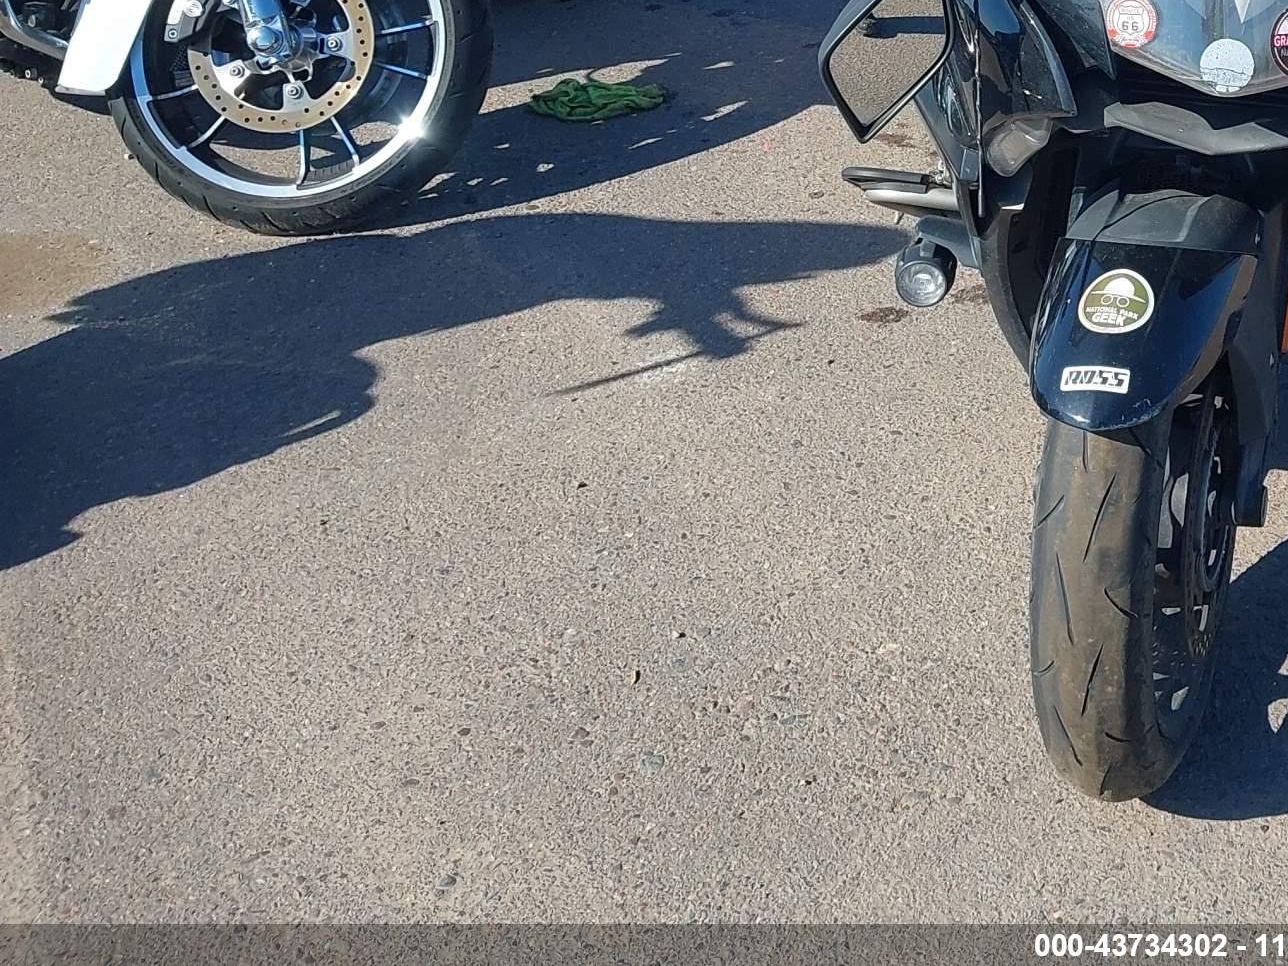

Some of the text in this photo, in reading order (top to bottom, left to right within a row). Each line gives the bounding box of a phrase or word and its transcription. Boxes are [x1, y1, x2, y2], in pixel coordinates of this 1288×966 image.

[1121, 21, 1139, 31] 66
[1085, 306, 1139, 320] NATIONAL PARK
[1092, 313, 1127, 326] GEEK
